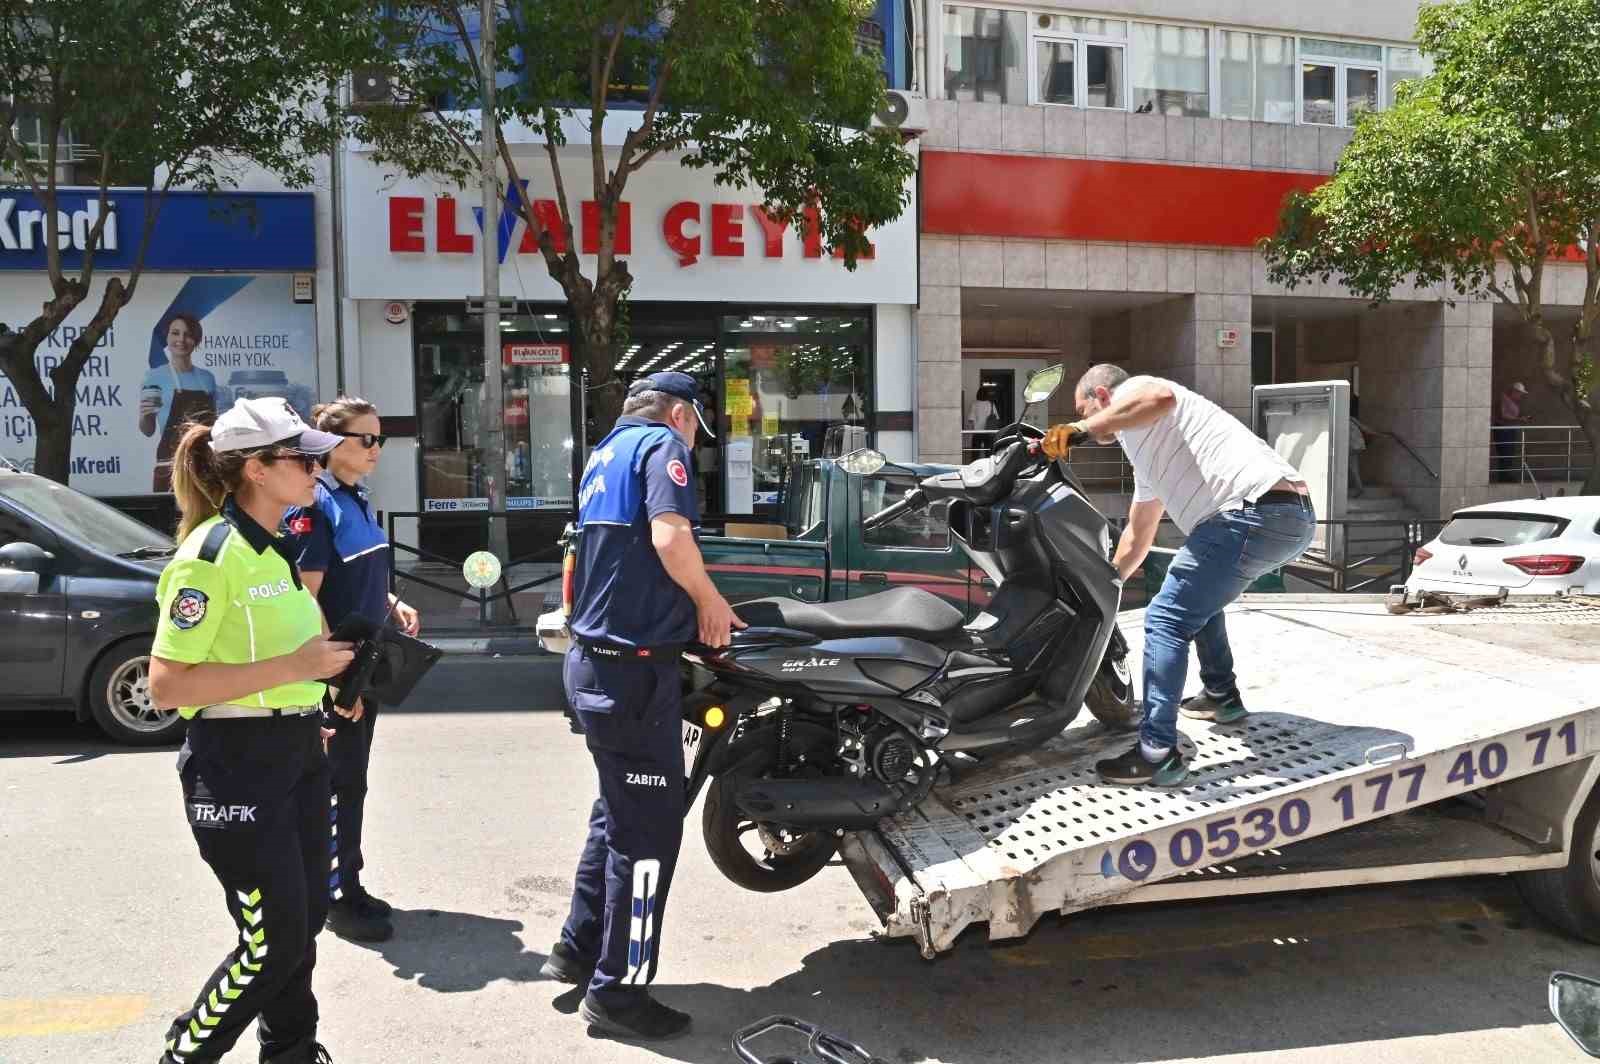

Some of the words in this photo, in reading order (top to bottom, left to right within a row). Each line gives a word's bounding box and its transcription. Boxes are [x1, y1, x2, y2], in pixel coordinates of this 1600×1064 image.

[204, 335, 289, 349] HAYALLERDE
[204, 353, 241, 367] SINIR
[72, 415, 108, 436] AR.
[684, 726, 700, 747] AP
[626, 772, 667, 788] ZABITA
[1169, 798, 1311, 868] 0530
[1332, 763, 1427, 821] 177
[1447, 741, 1509, 786] 40
[1525, 720, 1578, 766] 71
